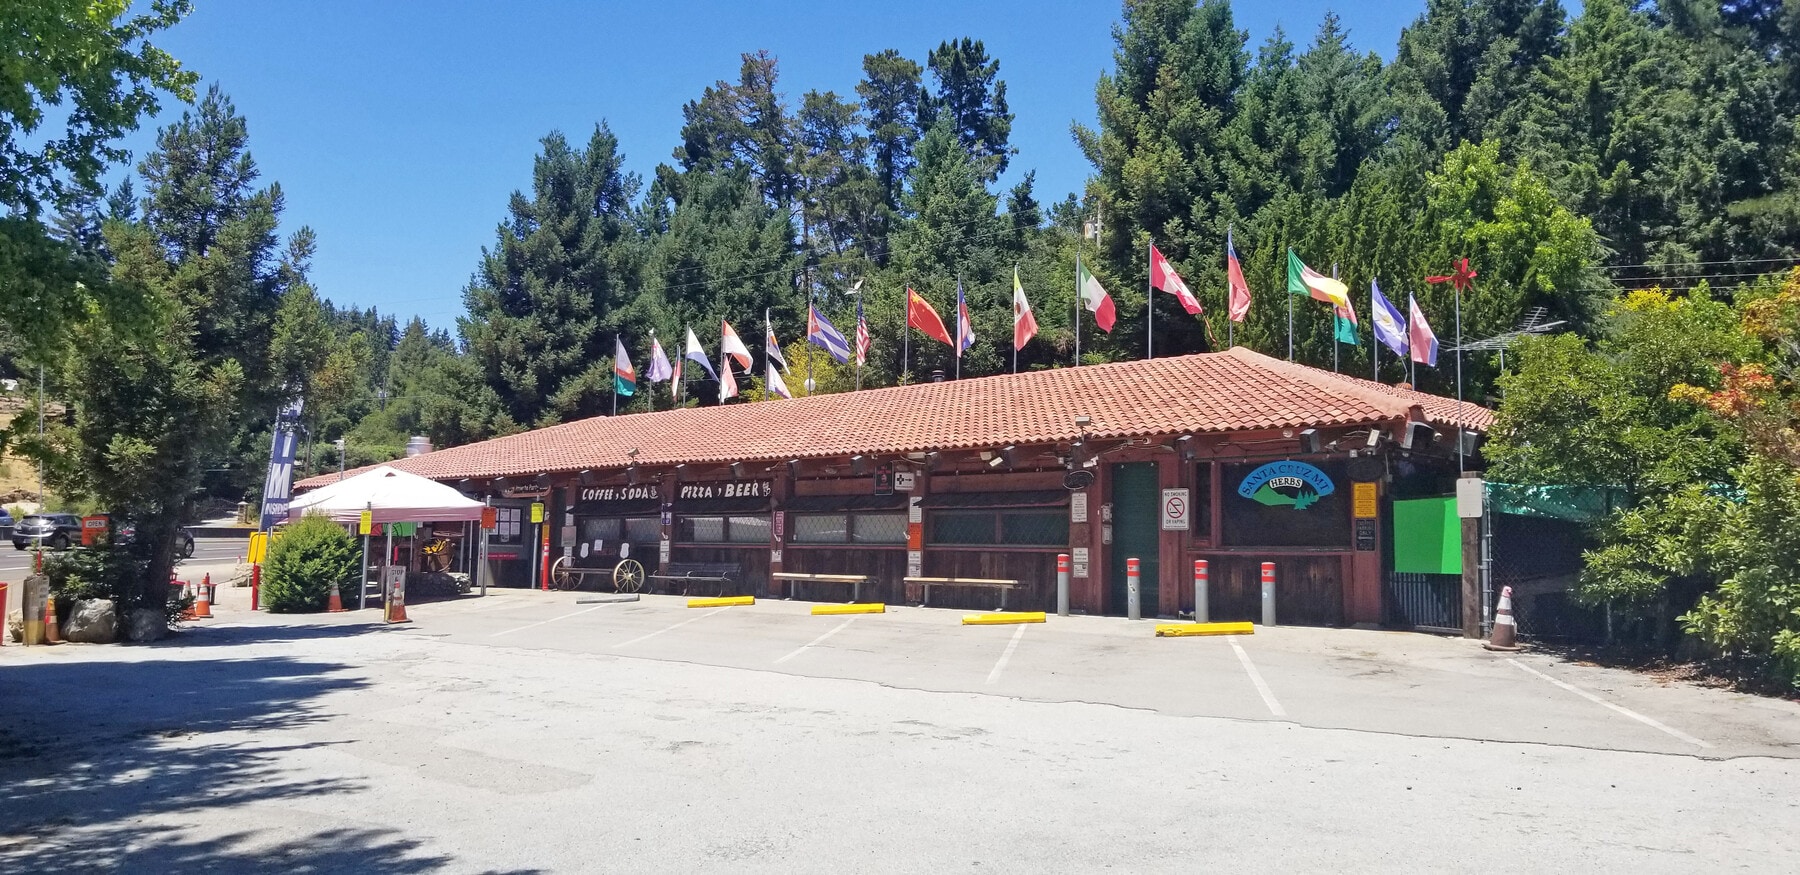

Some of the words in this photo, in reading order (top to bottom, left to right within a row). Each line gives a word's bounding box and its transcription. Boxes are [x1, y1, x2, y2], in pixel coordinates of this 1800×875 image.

[1242, 467, 1276, 495] SANTA
[1279, 464, 1312, 478] CRUZ
[1312, 474, 1329, 490] MT
[1271, 478, 1301, 488] HERBS
[621, 487, 648, 500] SODA
[724, 482, 759, 498] BEER
[264, 502, 288, 515] NSIDE
